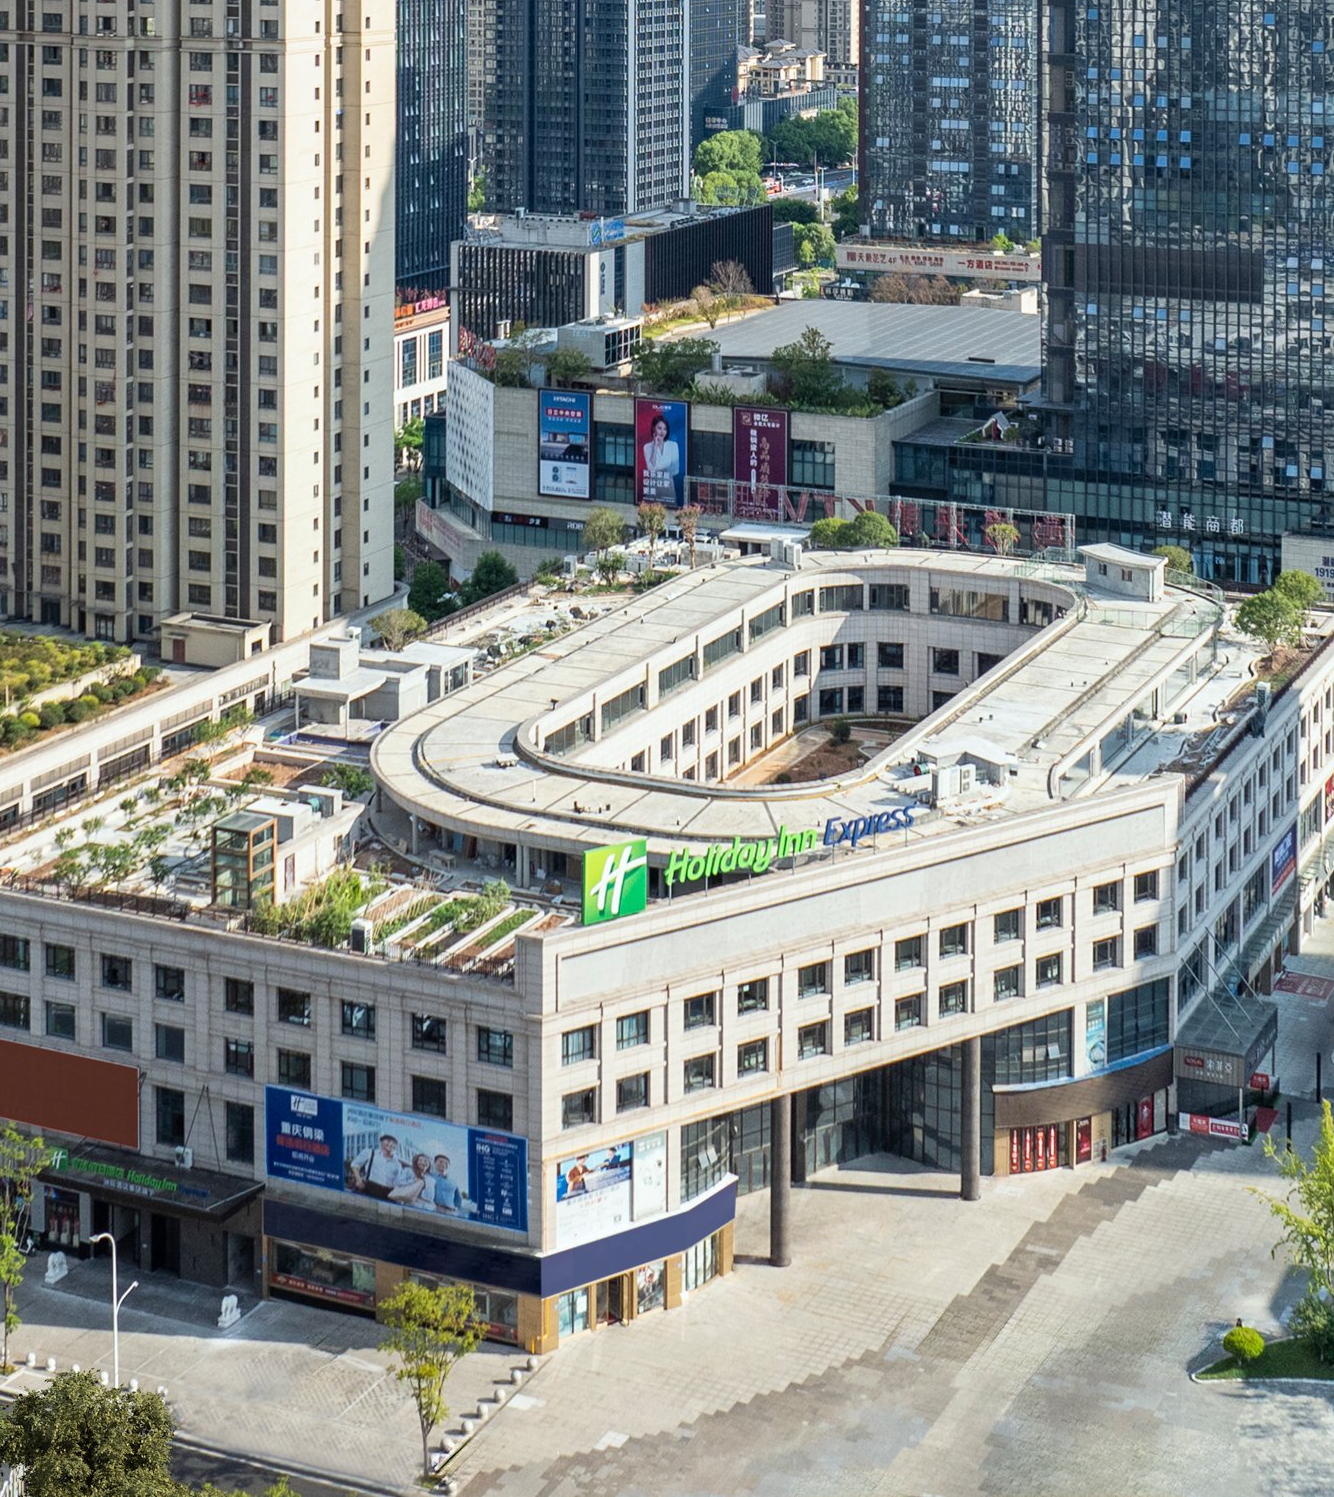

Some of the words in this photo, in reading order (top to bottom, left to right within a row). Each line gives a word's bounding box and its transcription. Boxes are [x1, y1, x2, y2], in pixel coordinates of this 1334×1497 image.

[1157, 511, 1215, 535] 潜能商都
[664, 834, 774, 887] Holiday
[778, 824, 818, 859] Inn
[823, 804, 919, 848] Express
[127, 1168, 162, 1191] Holiday
[161, 1176, 178, 1192] Inn
